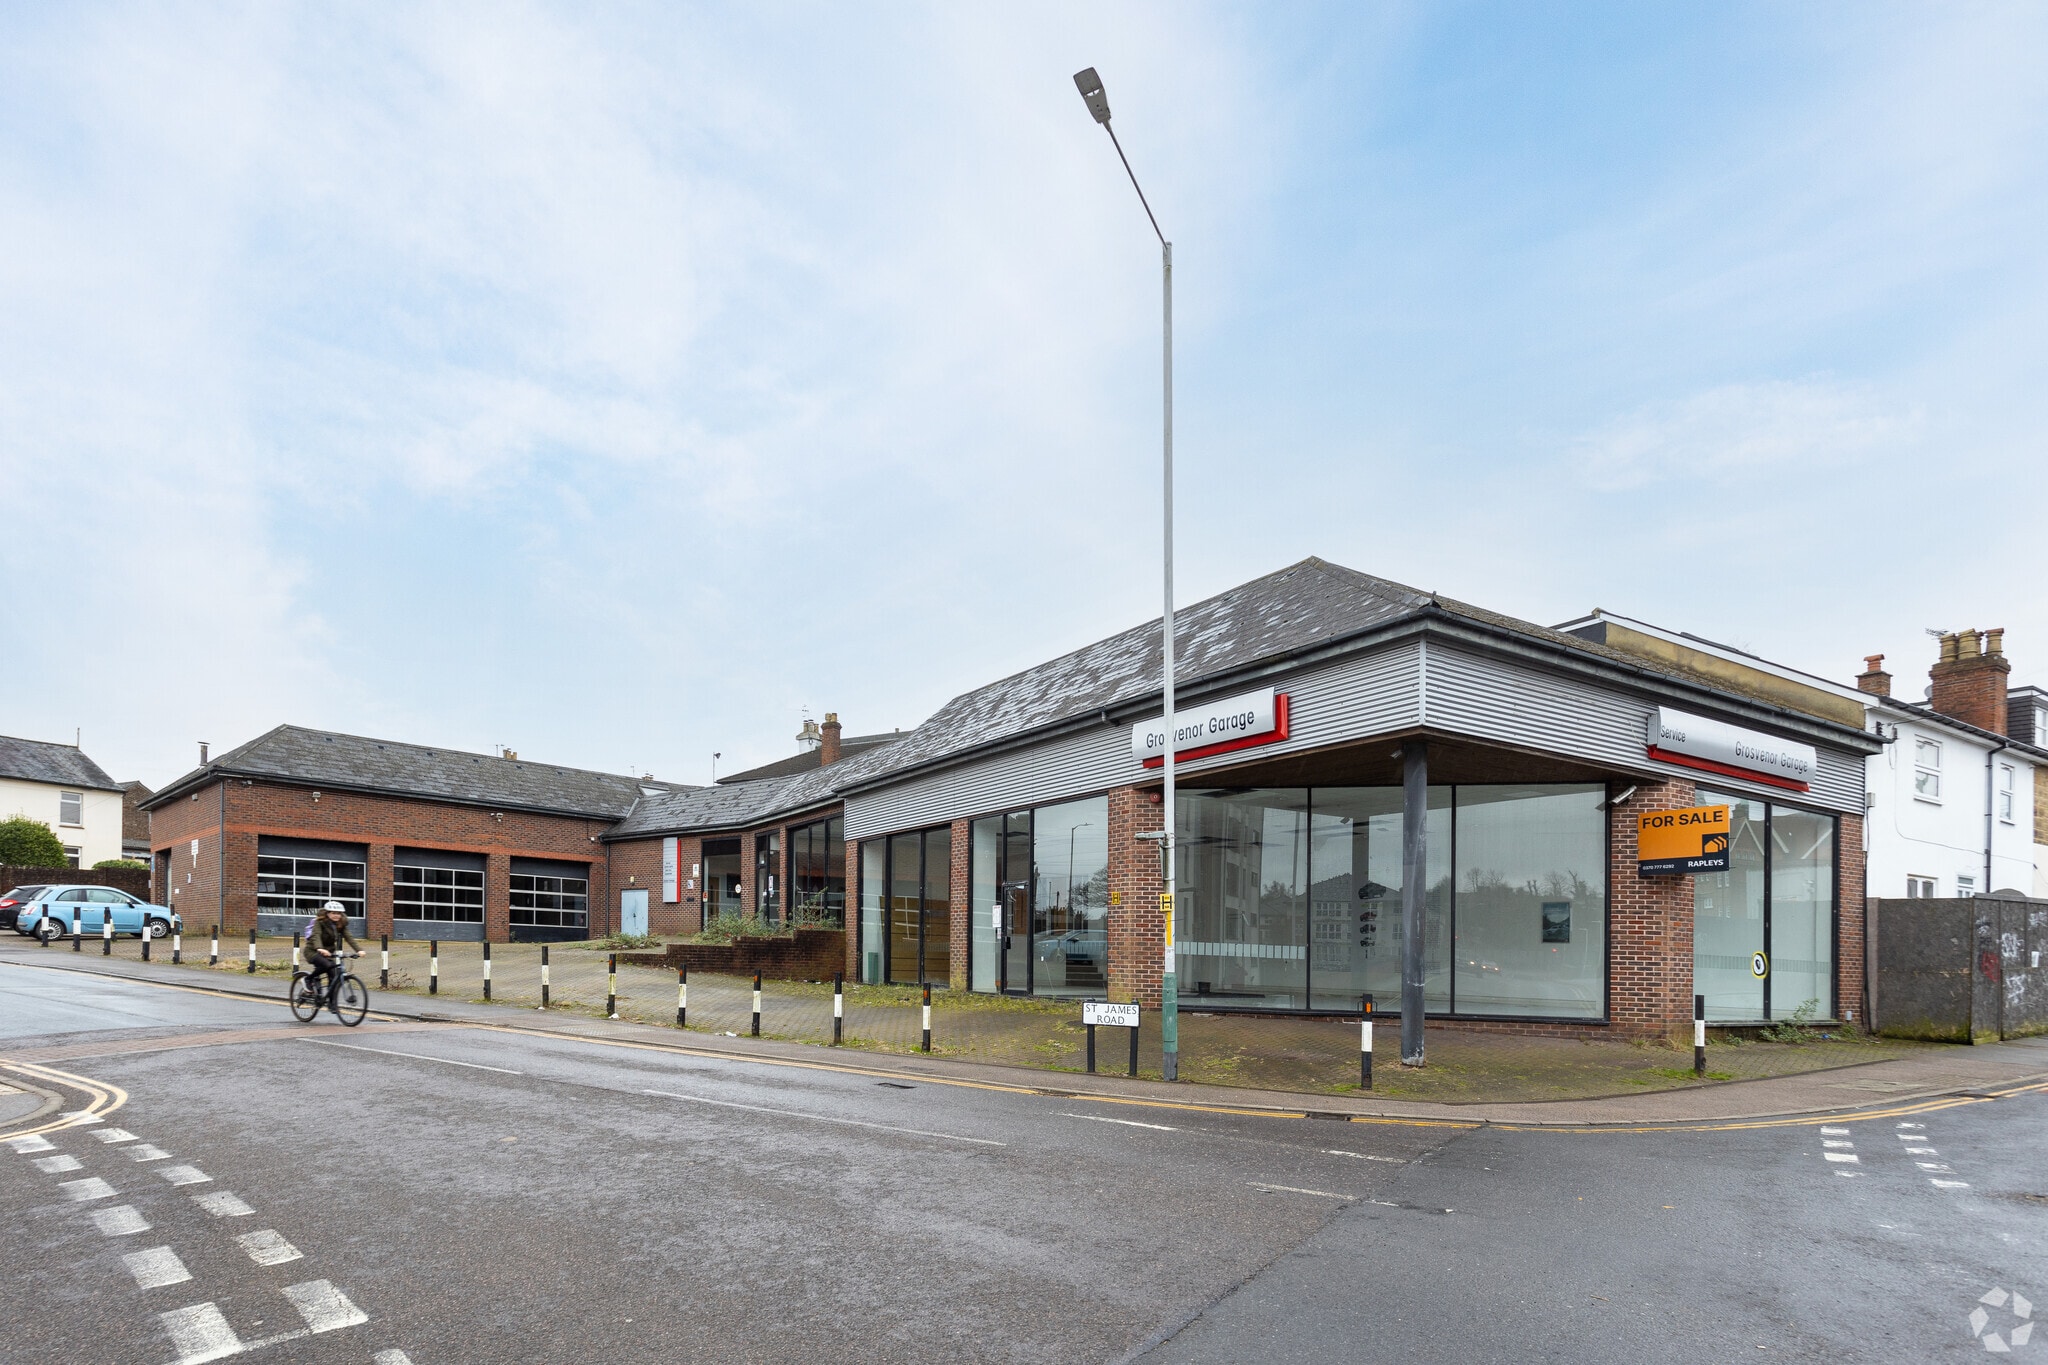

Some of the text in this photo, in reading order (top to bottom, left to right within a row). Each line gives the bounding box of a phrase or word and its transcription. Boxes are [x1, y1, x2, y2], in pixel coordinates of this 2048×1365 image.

[1146, 710, 1255, 749] Grovenor Garage
[1660, 725, 1686, 743] Service
[1735, 741, 1808, 775] Grosvenor Garage
[1642, 810, 1723, 829] FOR SALE
[1687, 859, 1724, 868] RAPLEYS
[1161, 895, 1172, 909] H
[1085, 1003, 1137, 1015] ST JAMES
[1096, 1015, 1125, 1025] ROAD
